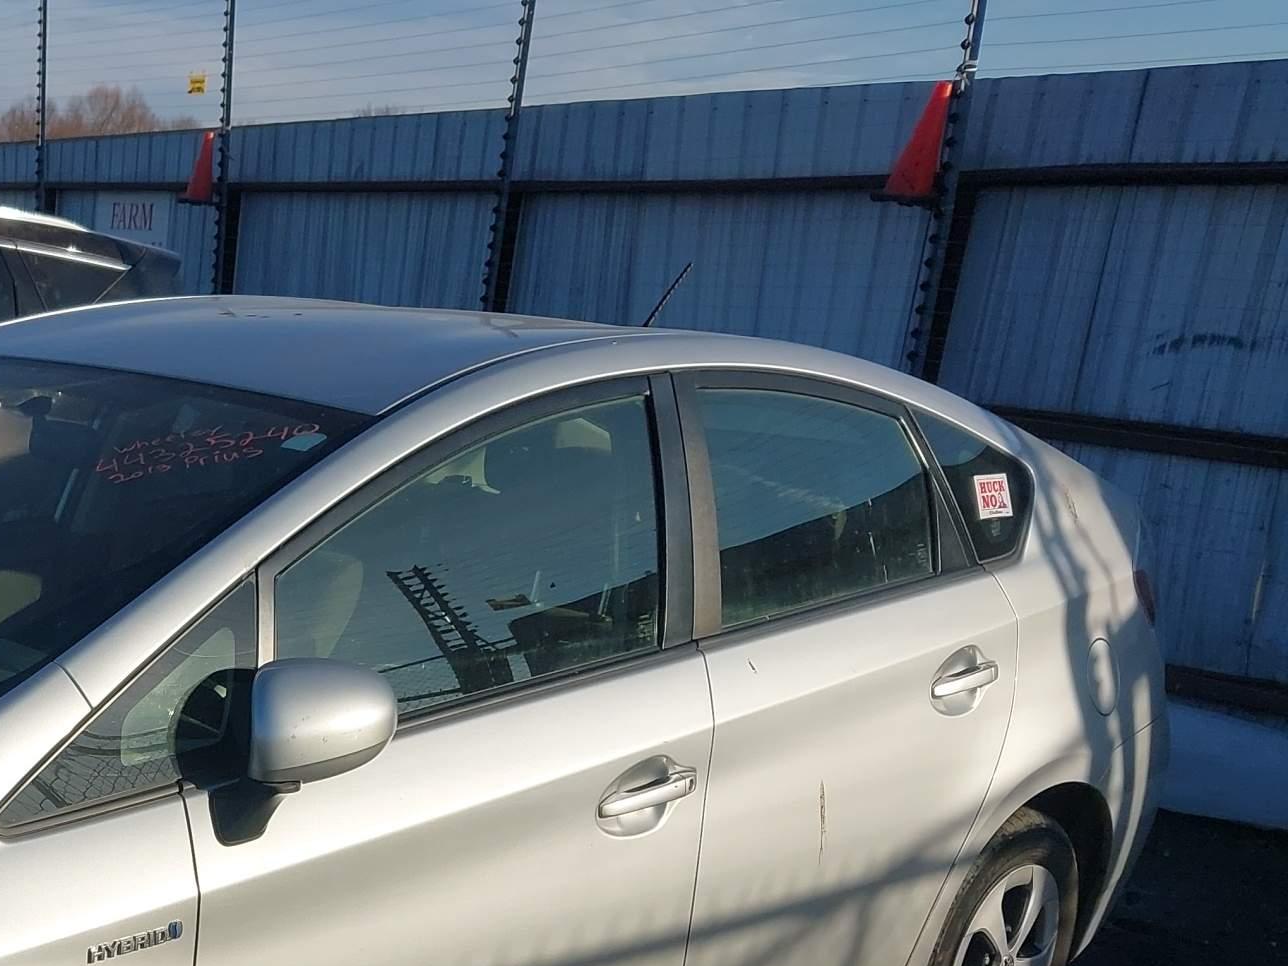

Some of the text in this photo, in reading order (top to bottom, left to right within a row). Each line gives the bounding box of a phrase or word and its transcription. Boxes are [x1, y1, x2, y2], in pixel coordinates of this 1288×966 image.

[111, 202, 154, 231] FARM
[95, 423, 320, 472] 44325240
[979, 480, 1005, 494] HUCK
[86, 927, 168, 965] HYBRID
